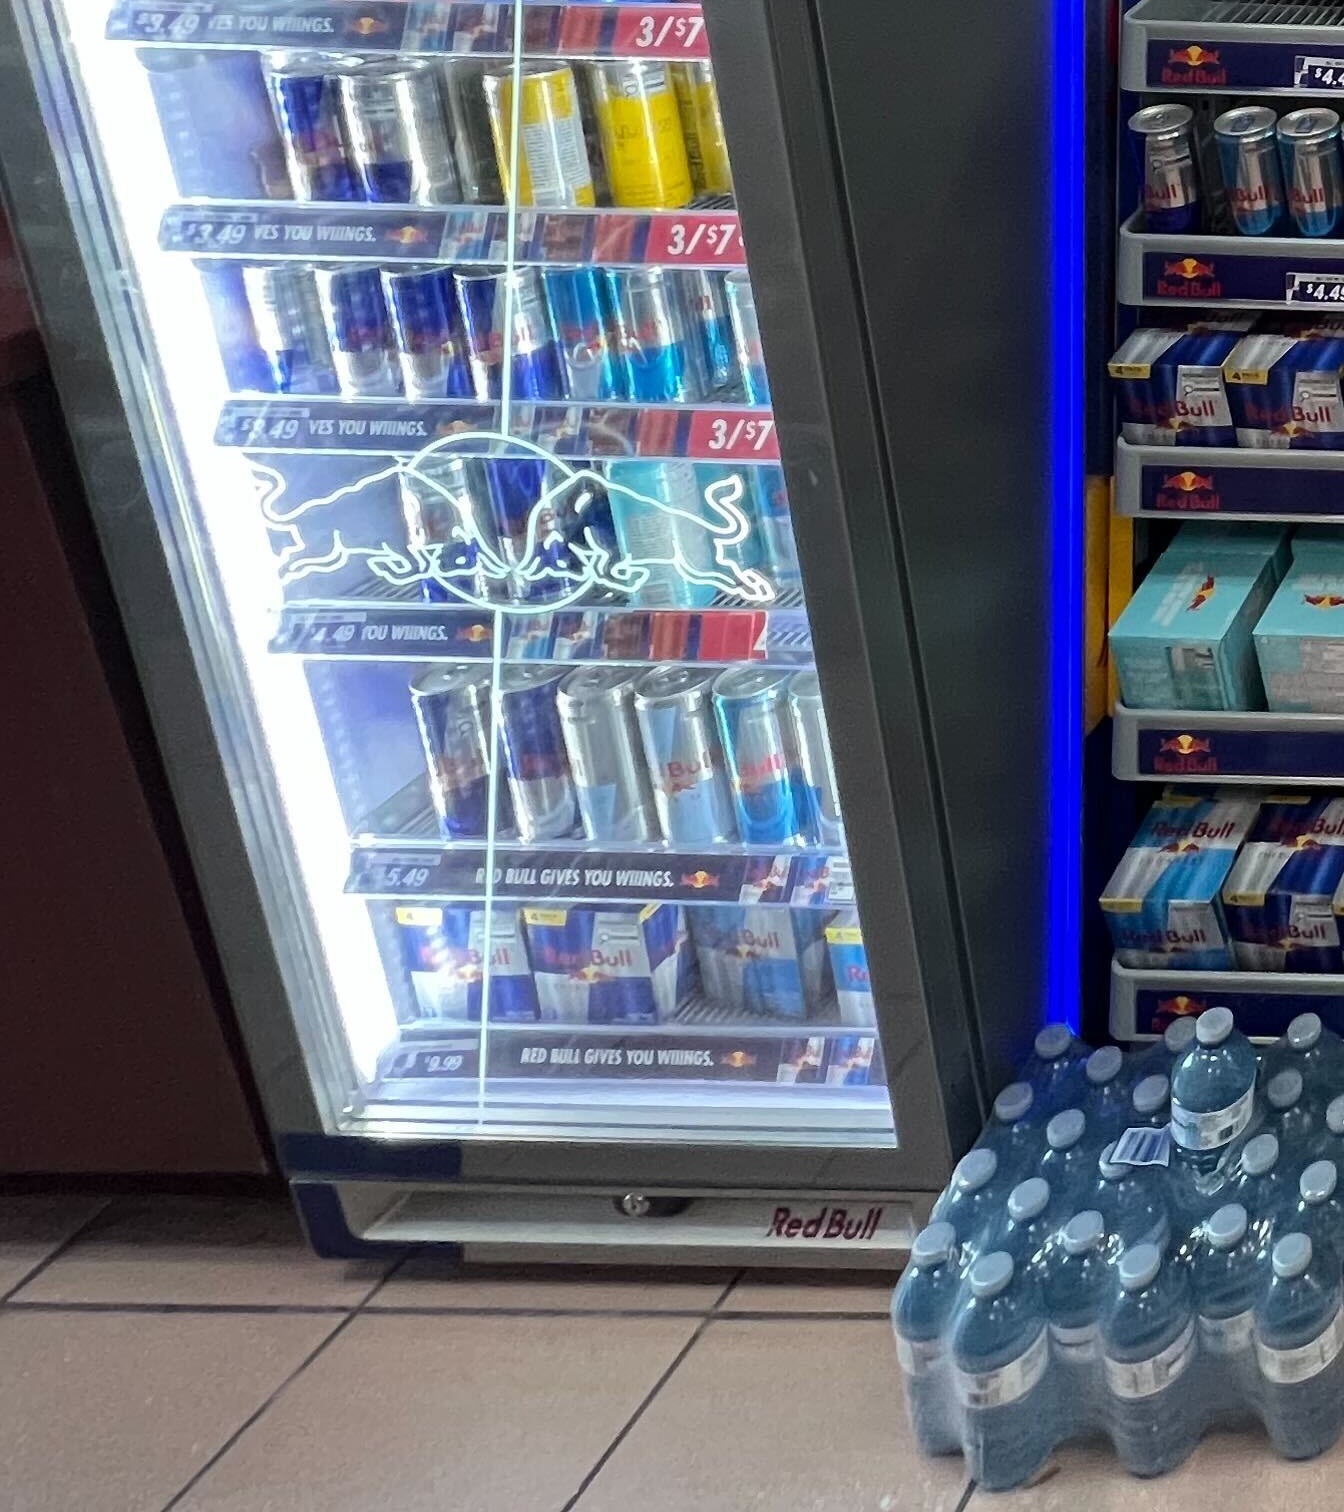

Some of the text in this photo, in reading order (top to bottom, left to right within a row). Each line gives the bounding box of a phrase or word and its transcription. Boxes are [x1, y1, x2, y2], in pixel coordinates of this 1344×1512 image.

[634, 14, 704, 48] 3/$7
[708, 419, 773, 451] 3/$7
[1191, 822, 1235, 839] Bull
[505, 868, 537, 886] BULL
[540, 868, 581, 887] GIVES
[583, 868, 612, 887] YOU
[520, 1048, 547, 1065] RED
[550, 1048, 580, 1066] BULL
[583, 1048, 623, 1066] GIVES
[626, 1048, 654, 1066] YOU
[765, 1208, 881, 1242] Red Bull
